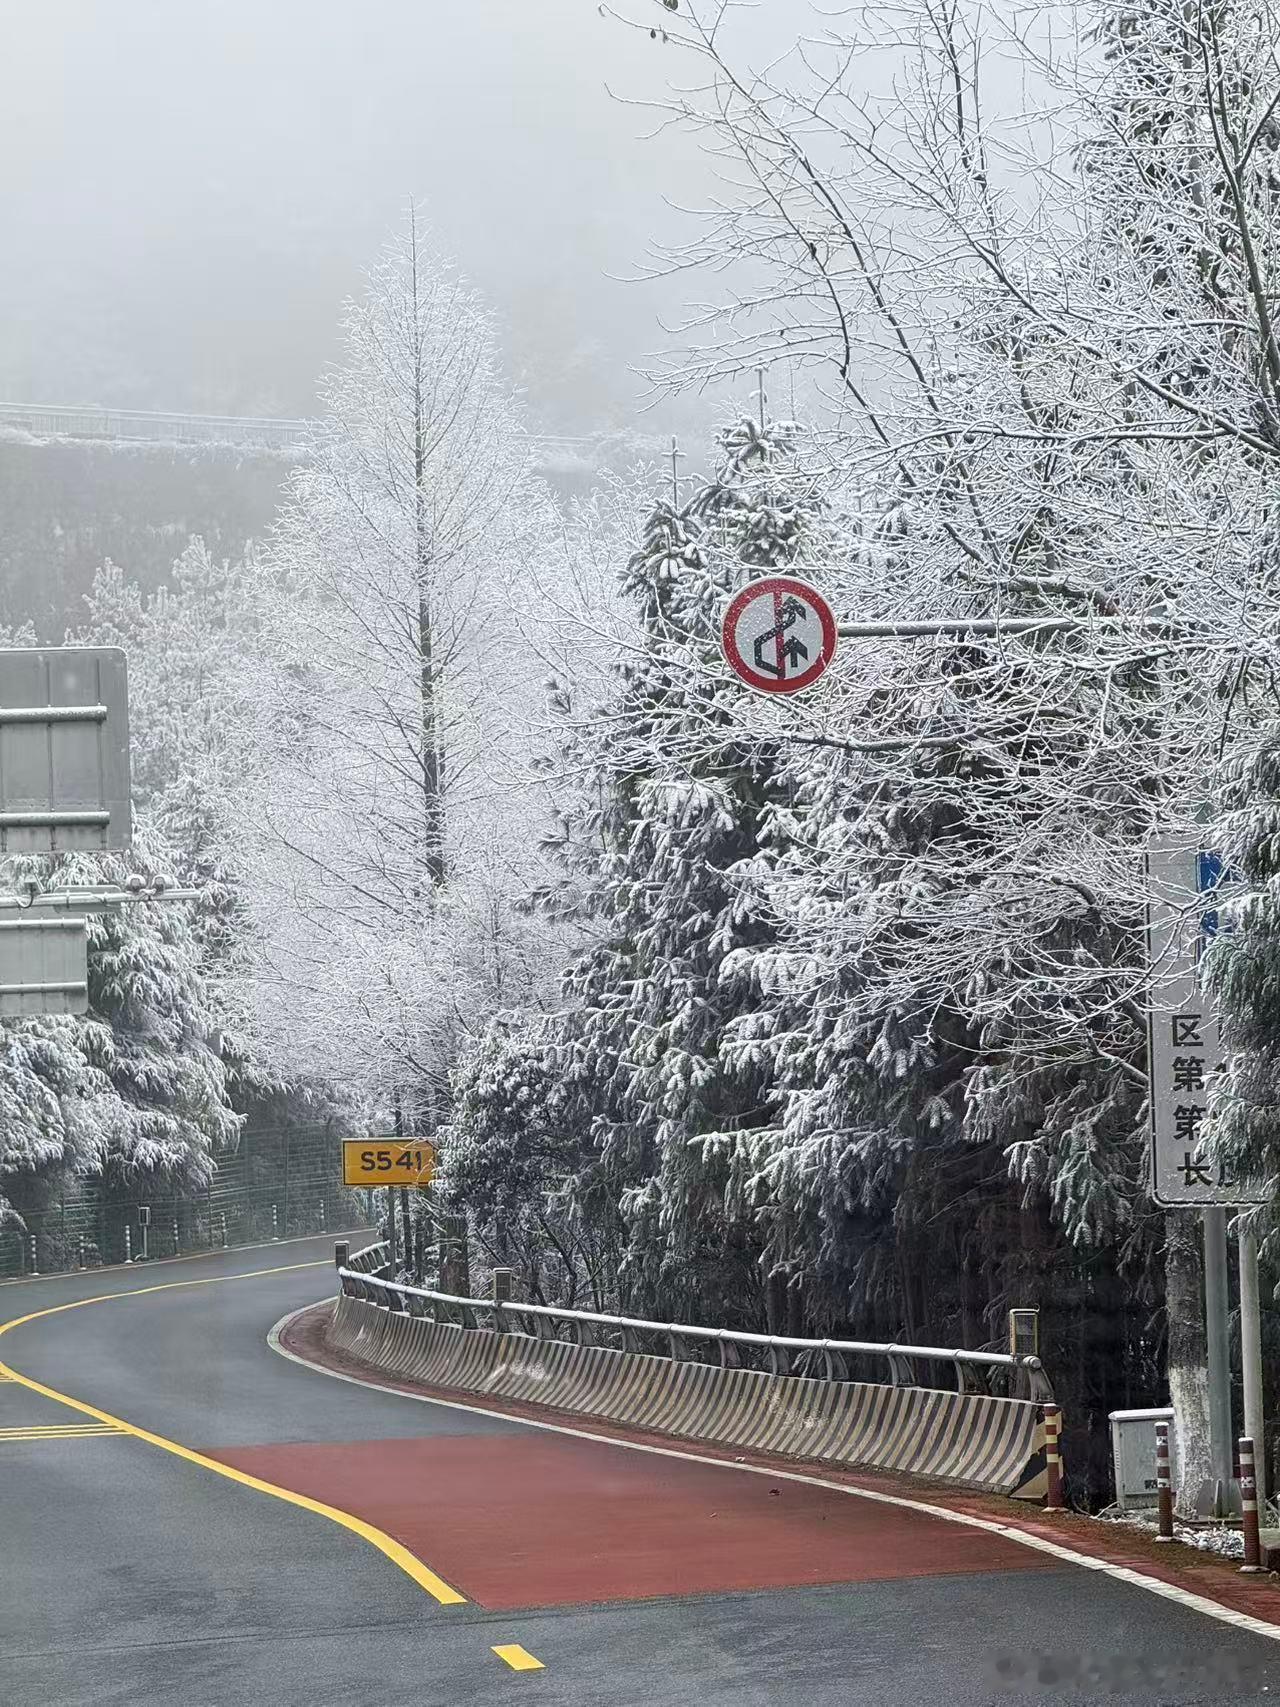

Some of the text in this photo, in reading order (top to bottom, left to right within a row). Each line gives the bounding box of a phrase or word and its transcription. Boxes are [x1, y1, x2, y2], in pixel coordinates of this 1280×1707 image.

[1172, 1014, 1224, 1047] 区
[1172, 1056, 1227, 1092] 第
[360, 1151, 422, 1171] S541
